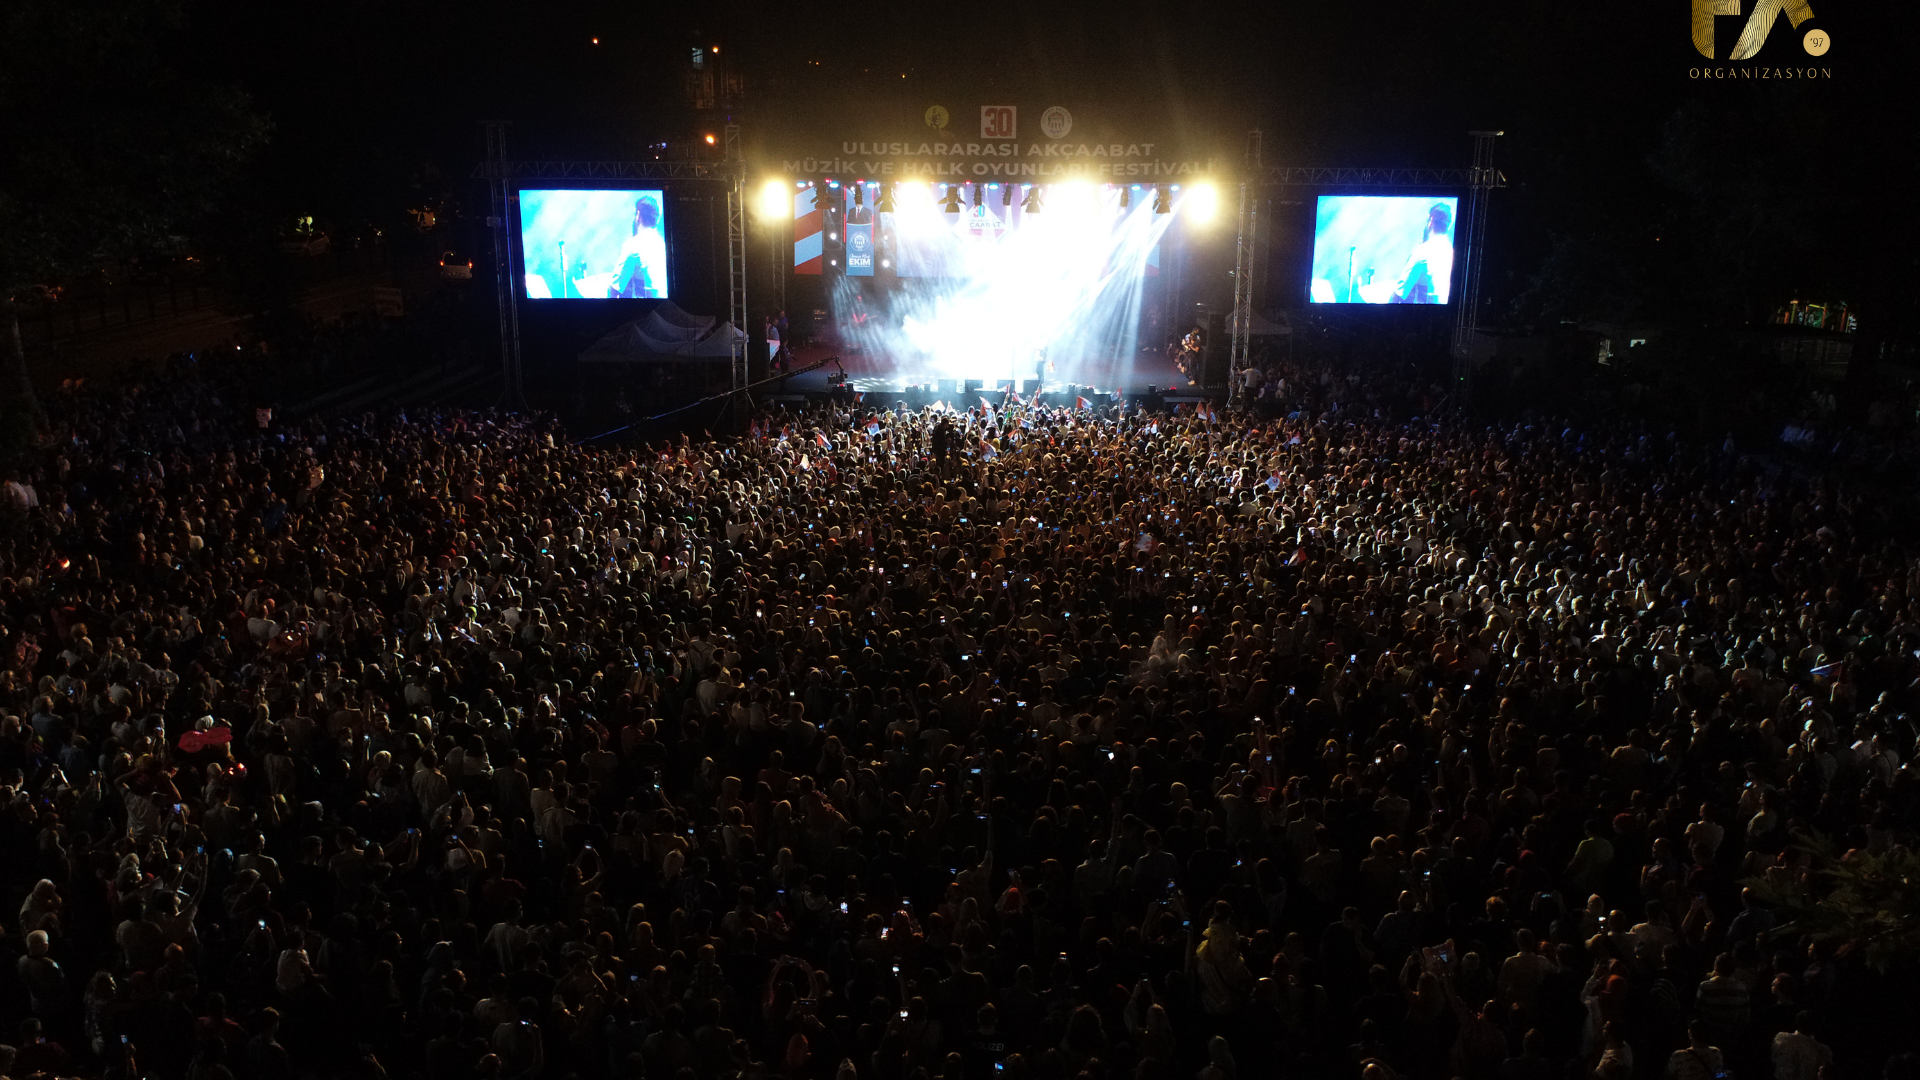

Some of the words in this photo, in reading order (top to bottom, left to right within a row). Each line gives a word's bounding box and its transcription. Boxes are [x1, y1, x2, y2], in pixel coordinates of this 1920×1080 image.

[985, 107, 1013, 137] 30
[843, 141, 1018, 156] ULUSLARARASI
[1027, 143, 1155, 159] AKÇAABAT
[783, 157, 857, 174] MÜZİK
[864, 162, 894, 174] VE
[903, 162, 964, 175] HALK
[972, 162, 1089, 176] OYUNLARI
[1099, 158, 1214, 176] FESTİVALİ
